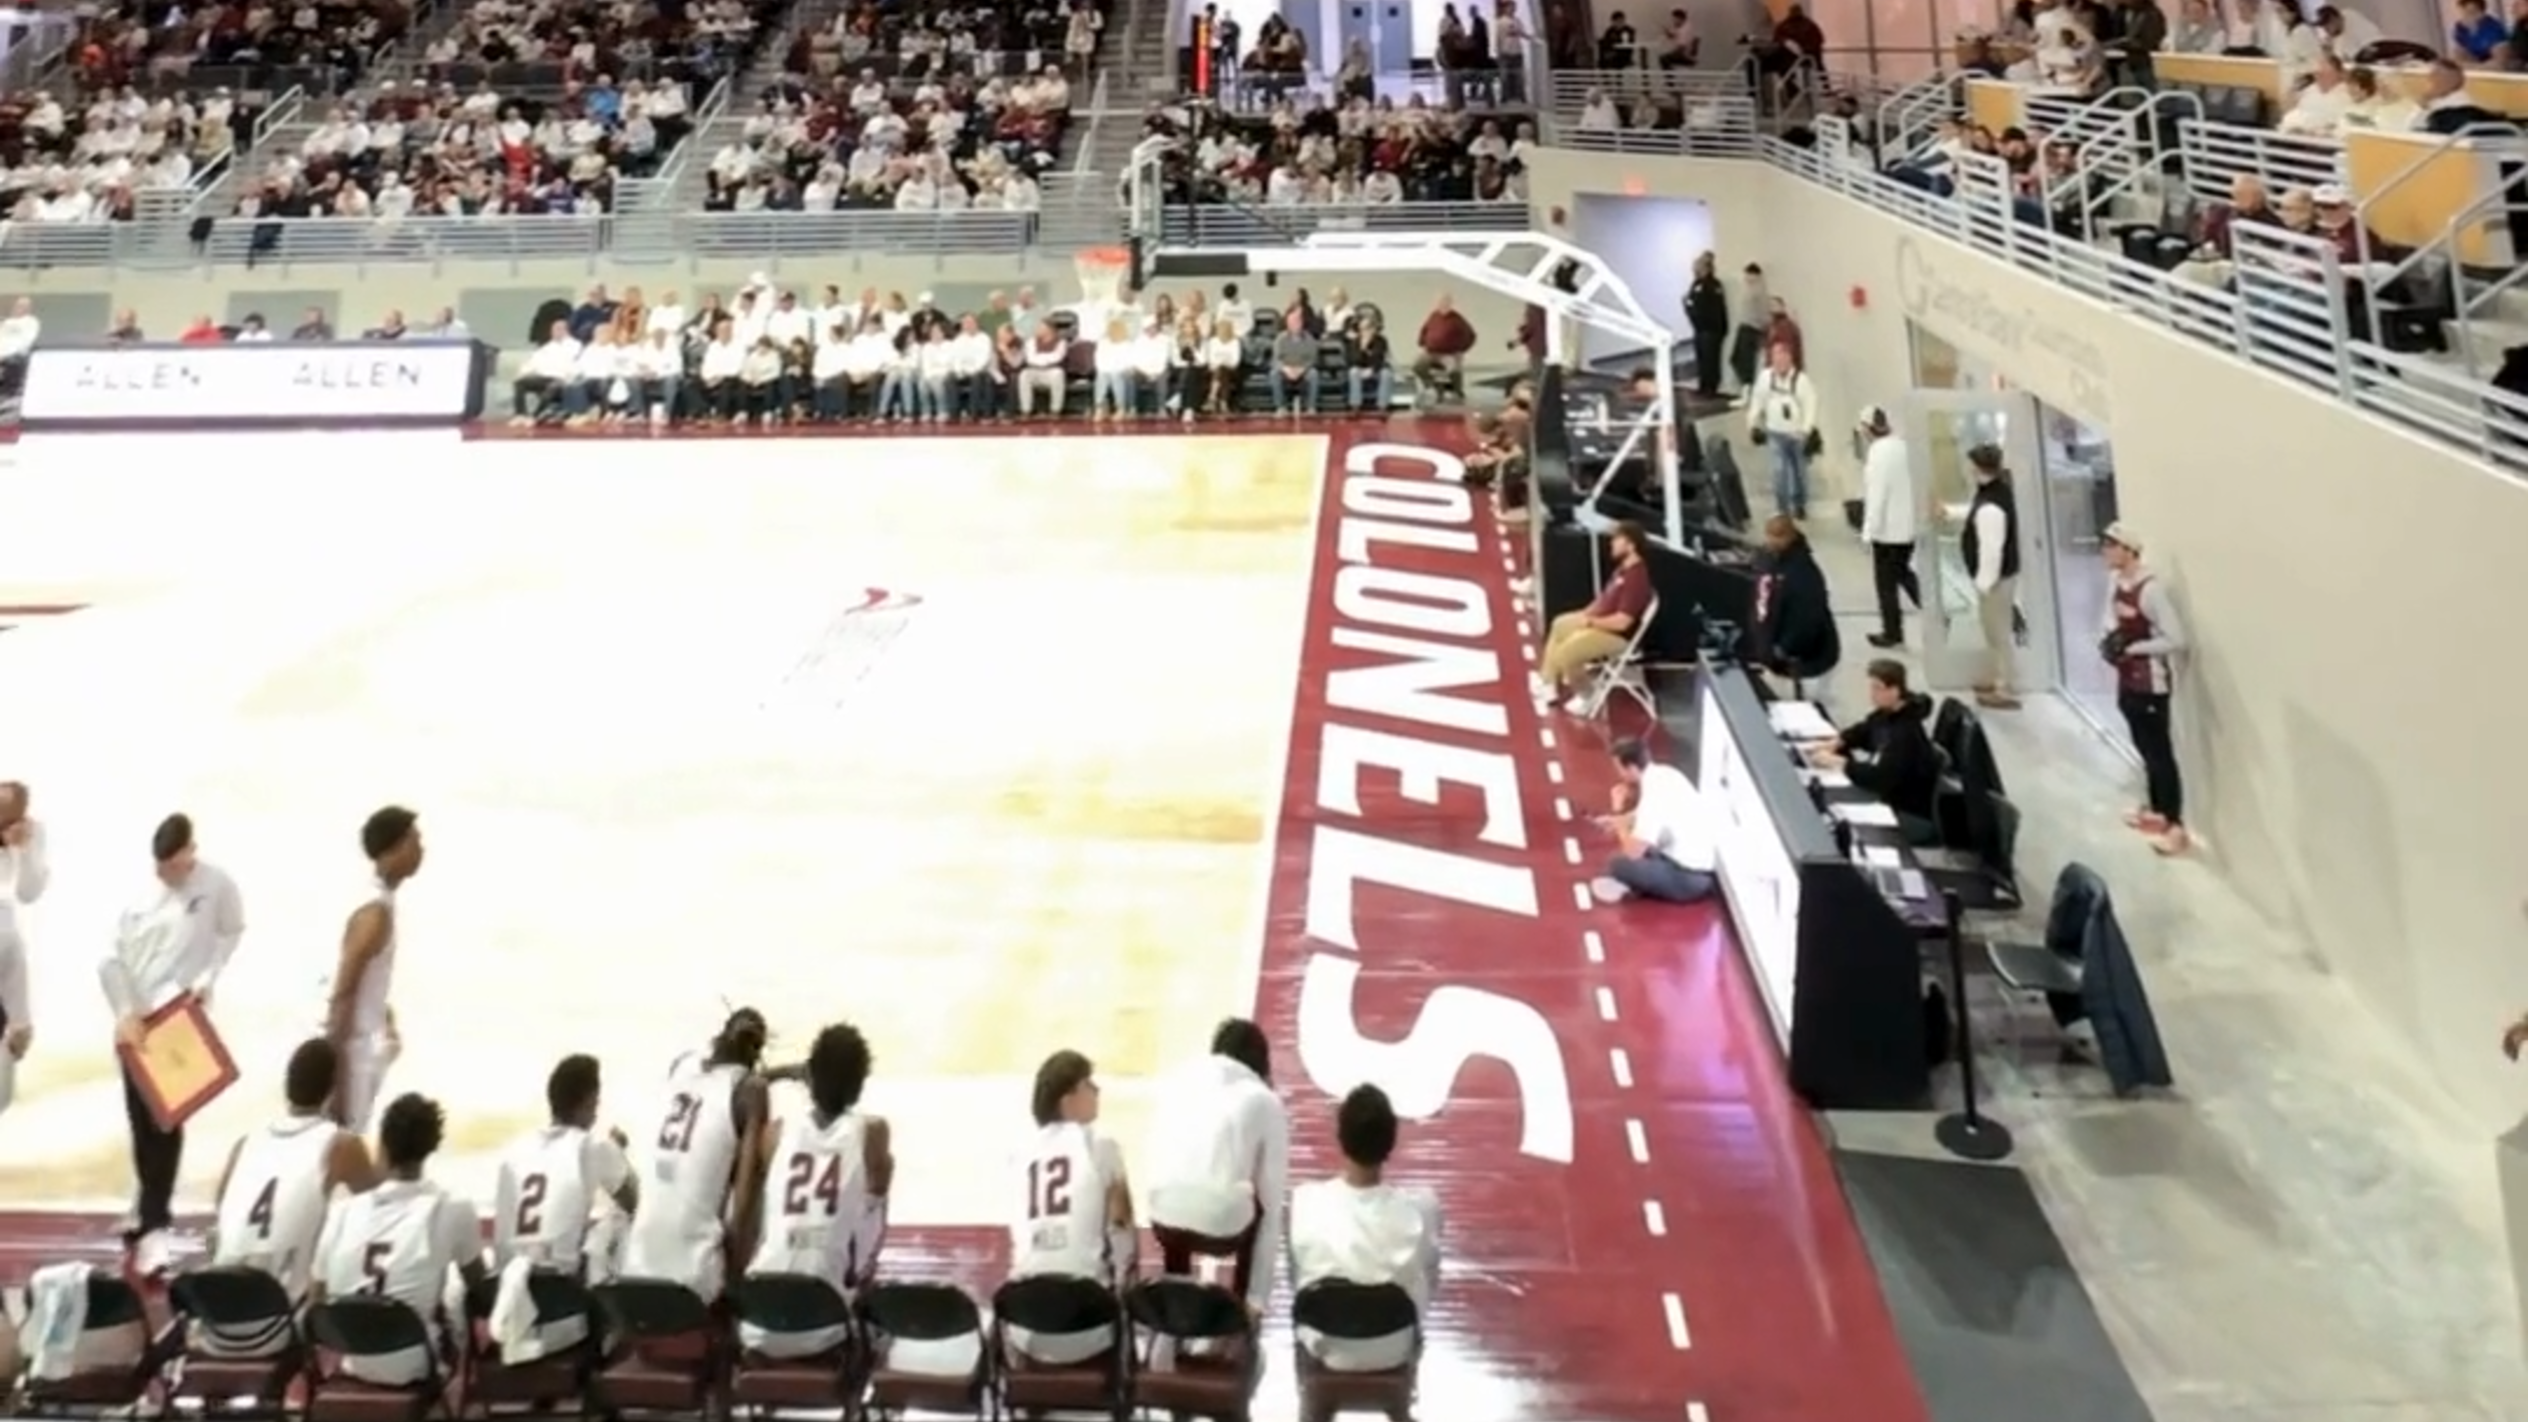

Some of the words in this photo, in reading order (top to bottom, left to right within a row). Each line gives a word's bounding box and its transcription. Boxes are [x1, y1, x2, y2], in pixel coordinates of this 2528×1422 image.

[76, 362, 202, 390] ALLEN
[292, 360, 423, 389] ALLEN
[1298, 442, 1575, 1165] COLONELS
[658, 1092, 704, 1153] 21
[247, 1177, 279, 1239] 4
[516, 1173, 548, 1236] 2
[784, 1151, 842, 1217] 24
[1028, 1156, 1071, 1219] 12
[362, 1241, 394, 1297] 5
